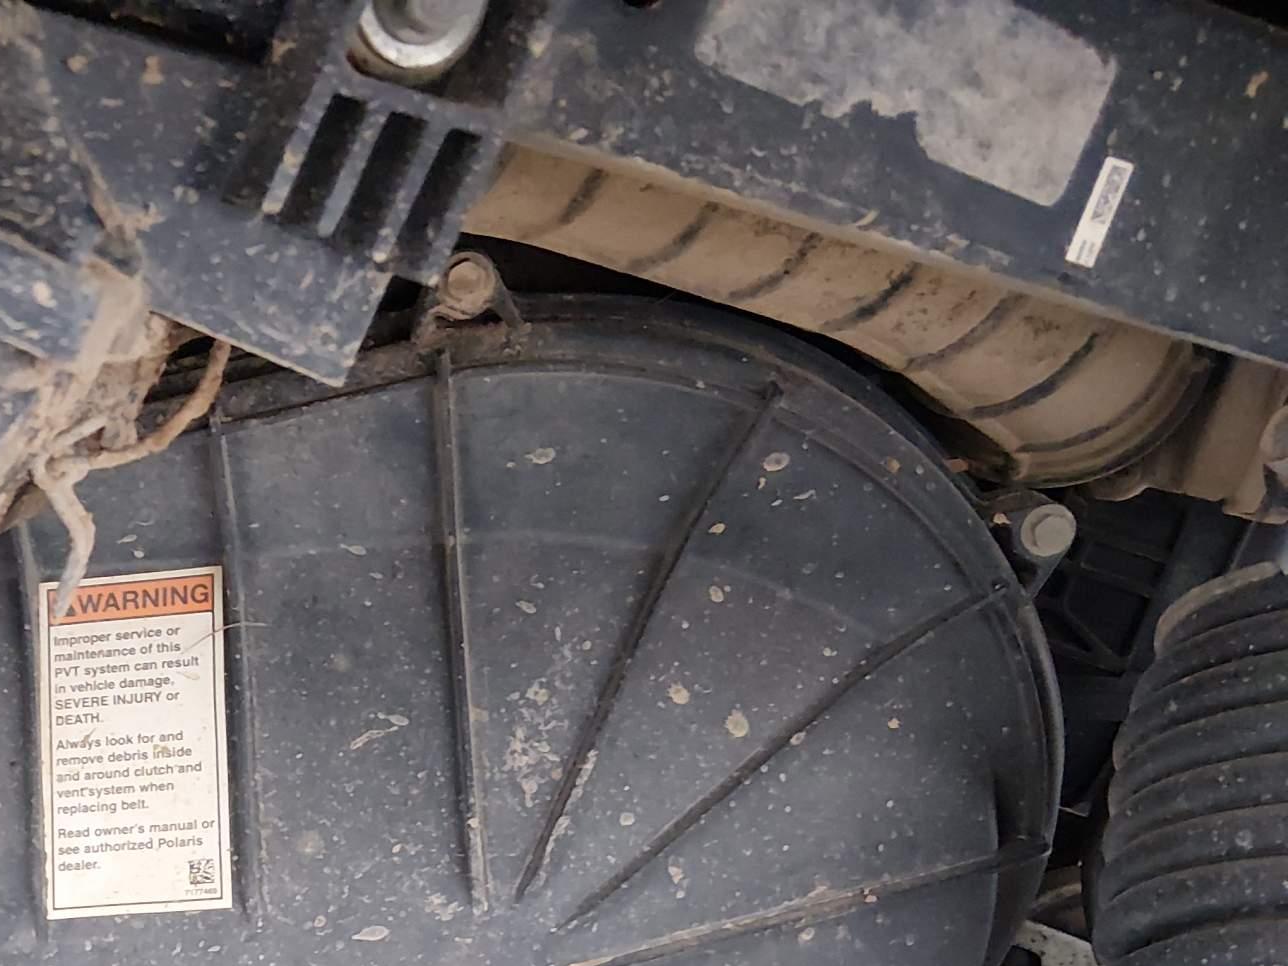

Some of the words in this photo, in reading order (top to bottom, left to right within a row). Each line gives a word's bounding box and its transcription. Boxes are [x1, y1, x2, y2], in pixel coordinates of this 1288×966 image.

[76, 583, 210, 614] WARNING
[54, 633, 111, 647] Improper
[115, 628, 162, 640] service
[166, 627, 180, 635] or
[54, 646, 136, 661] maintenance
[140, 643, 152, 654] of
[157, 642, 180, 652] this
[55, 666, 80, 678] PVT
[84, 664, 130, 678] system
[134, 662, 157, 671] can
[162, 656, 198, 668] result
[55, 684, 66, 693] in
[71, 680, 115, 692] vehicle
[120, 677, 174, 690] damage,
[55, 696, 108, 710] SEVERE
[113, 691, 162, 705] INJURY
[166, 692, 180, 700] or
[56, 713, 104, 726] DEATH.
[56, 739, 101, 750] Always
[106, 734, 133, 746] look
[138, 733, 154, 744] for
[159, 732, 183, 742] and
[56, 755, 103, 766] remove
[107, 750, 148, 762] debris
[153, 747, 192, 759] inside
[56, 772, 80, 783] and
[84, 767, 130, 780] around
[134, 765, 174, 777] clutch
[178, 762, 202, 773] and
[56, 788, 84, 798] vent
[88, 784, 135, 798] system
[140, 781, 174, 792] when
[58, 802, 116, 816] replacing
[121, 800, 149, 810] belt.
[58, 828, 90, 838] Read
[95, 824, 145, 837] owner's
[149, 820, 197, 832] manual
[202, 819, 215, 829] or
[58, 846, 79, 855] see
[84, 839, 153, 854] authorized
[158, 836, 203, 849] Polaris
[58, 860, 101, 871] dealer.
